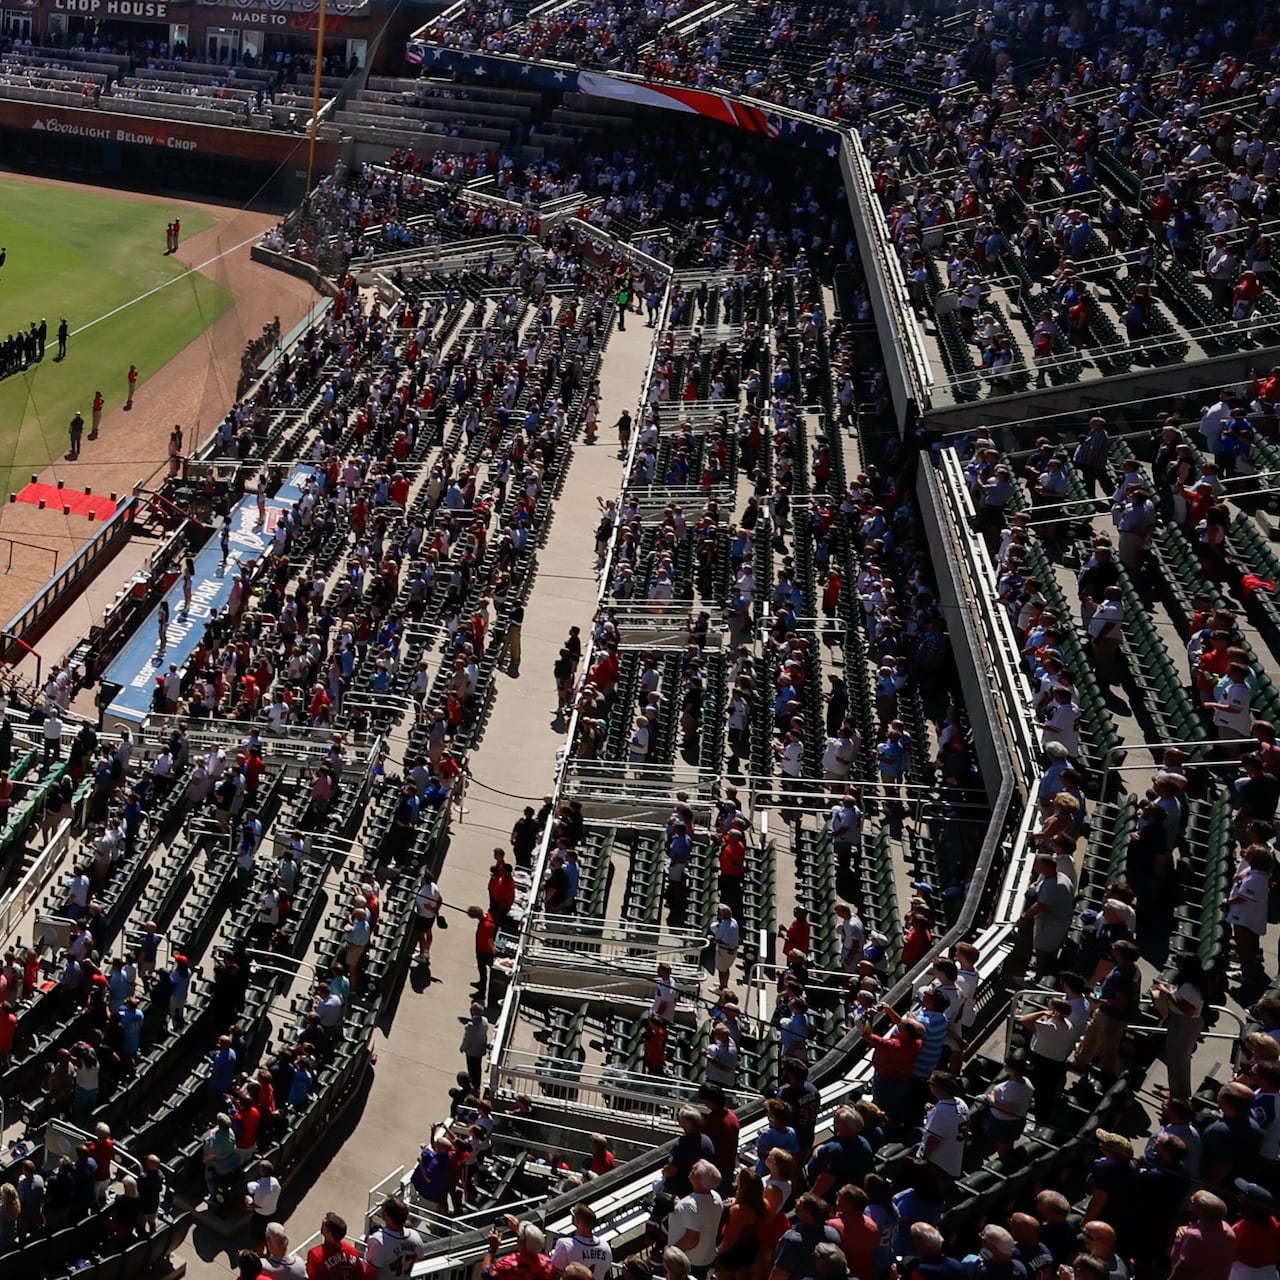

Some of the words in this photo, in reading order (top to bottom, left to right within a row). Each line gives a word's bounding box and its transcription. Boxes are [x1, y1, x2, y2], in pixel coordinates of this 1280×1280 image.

[108, 0, 167, 18] HOUSE
[232, 12, 268, 23] MADE
[271, 15, 287, 25] TO
[46, 119, 80, 135] Coors
[79, 127, 111, 139] LIGHT
[117, 130, 153, 145] BELOW
[167, 137, 197, 151] CHOP
[195, 579, 225, 609] PARK
[389, 1254, 413, 1276] 47
[582, 1251, 607, 1261] ALBIES
